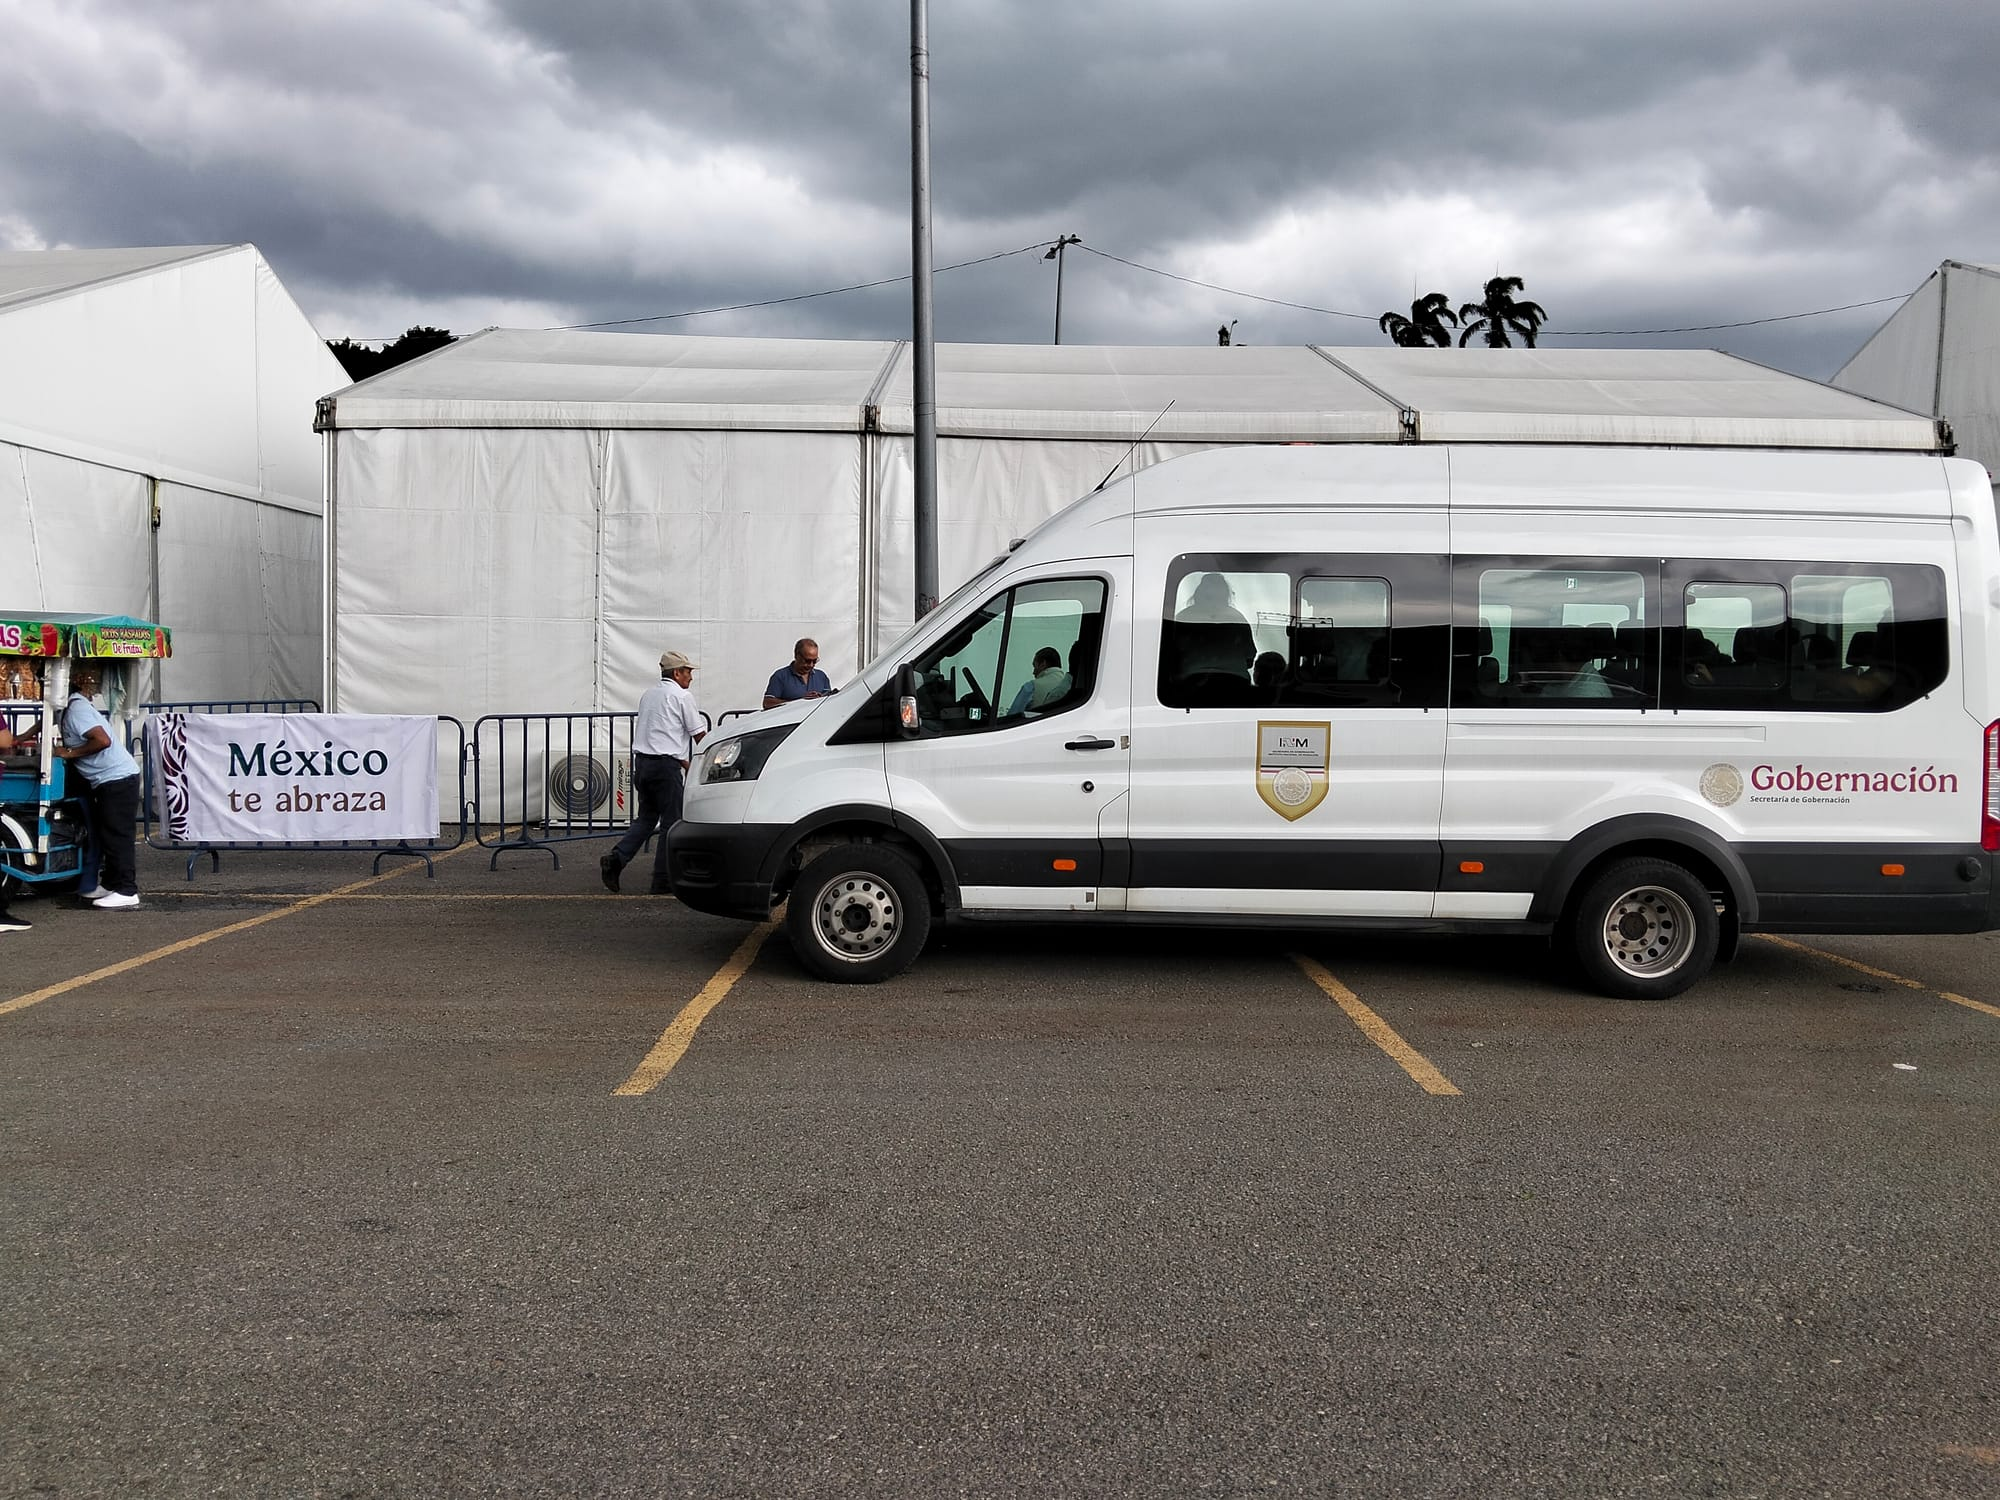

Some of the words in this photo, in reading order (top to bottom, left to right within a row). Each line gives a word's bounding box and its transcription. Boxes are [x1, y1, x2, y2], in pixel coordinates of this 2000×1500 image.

[227, 740, 388, 777] México
[1751, 764, 1958, 793] Gobernación
[227, 788, 262, 812] te
[275, 785, 386, 812] abraza
[1750, 795, 1789, 803] Secretaría
[1801, 796, 1850, 804] Gobernación
